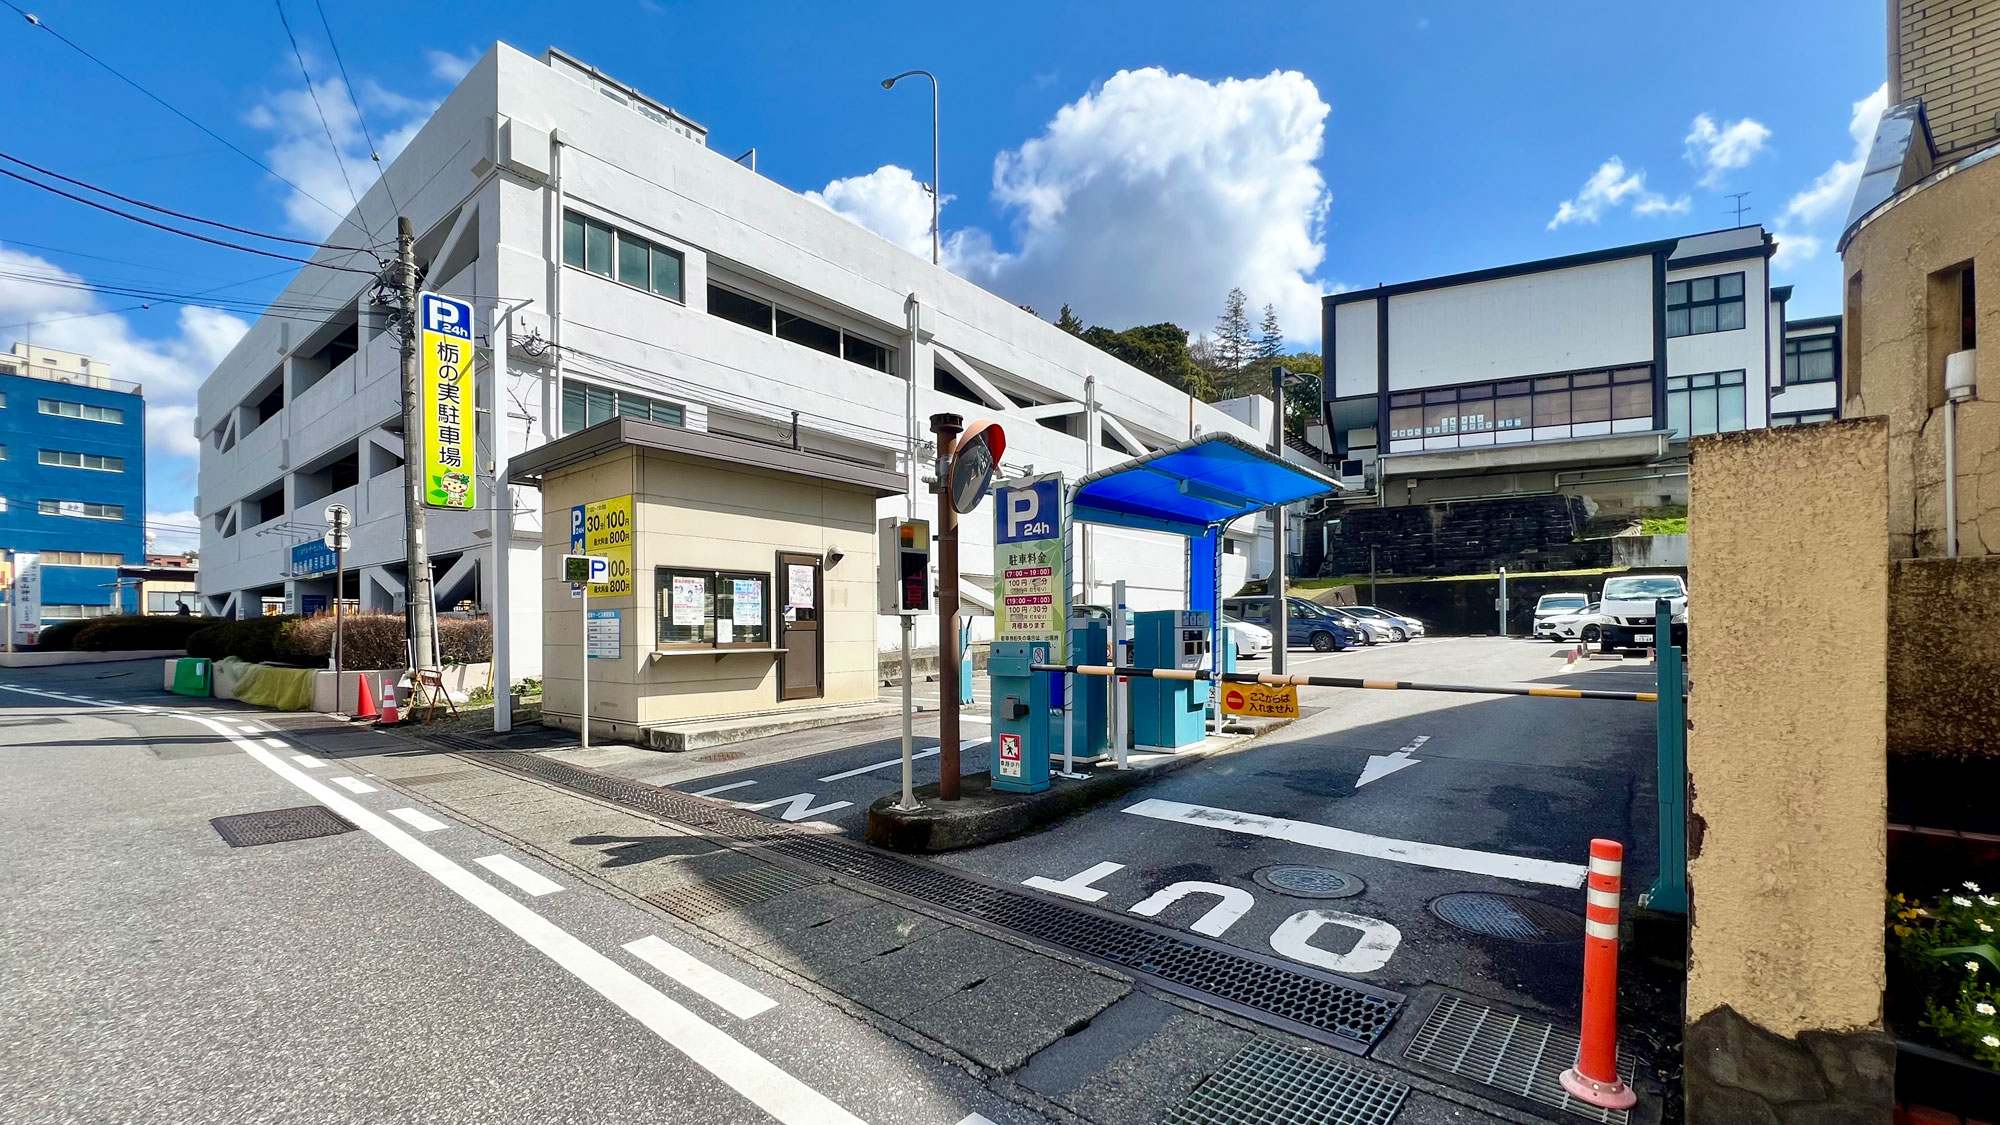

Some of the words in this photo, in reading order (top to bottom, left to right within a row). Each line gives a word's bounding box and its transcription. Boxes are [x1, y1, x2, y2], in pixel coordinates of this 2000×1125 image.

[429, 299, 459, 330] P
[443, 323, 468, 337] 24h
[437, 341, 461, 467] 栃の実駐車場
[572, 510, 582, 535] P
[1007, 490, 1039, 537] P
[1024, 522, 1050, 536] 24h
[591, 560, 606, 579] P
[1009, 551, 1047, 566] 駐車料金
[1249, 702, 1294, 713] 入れません
[1250, 692, 1290, 702] ここからは
[1021, 861, 1402, 973] OUT
